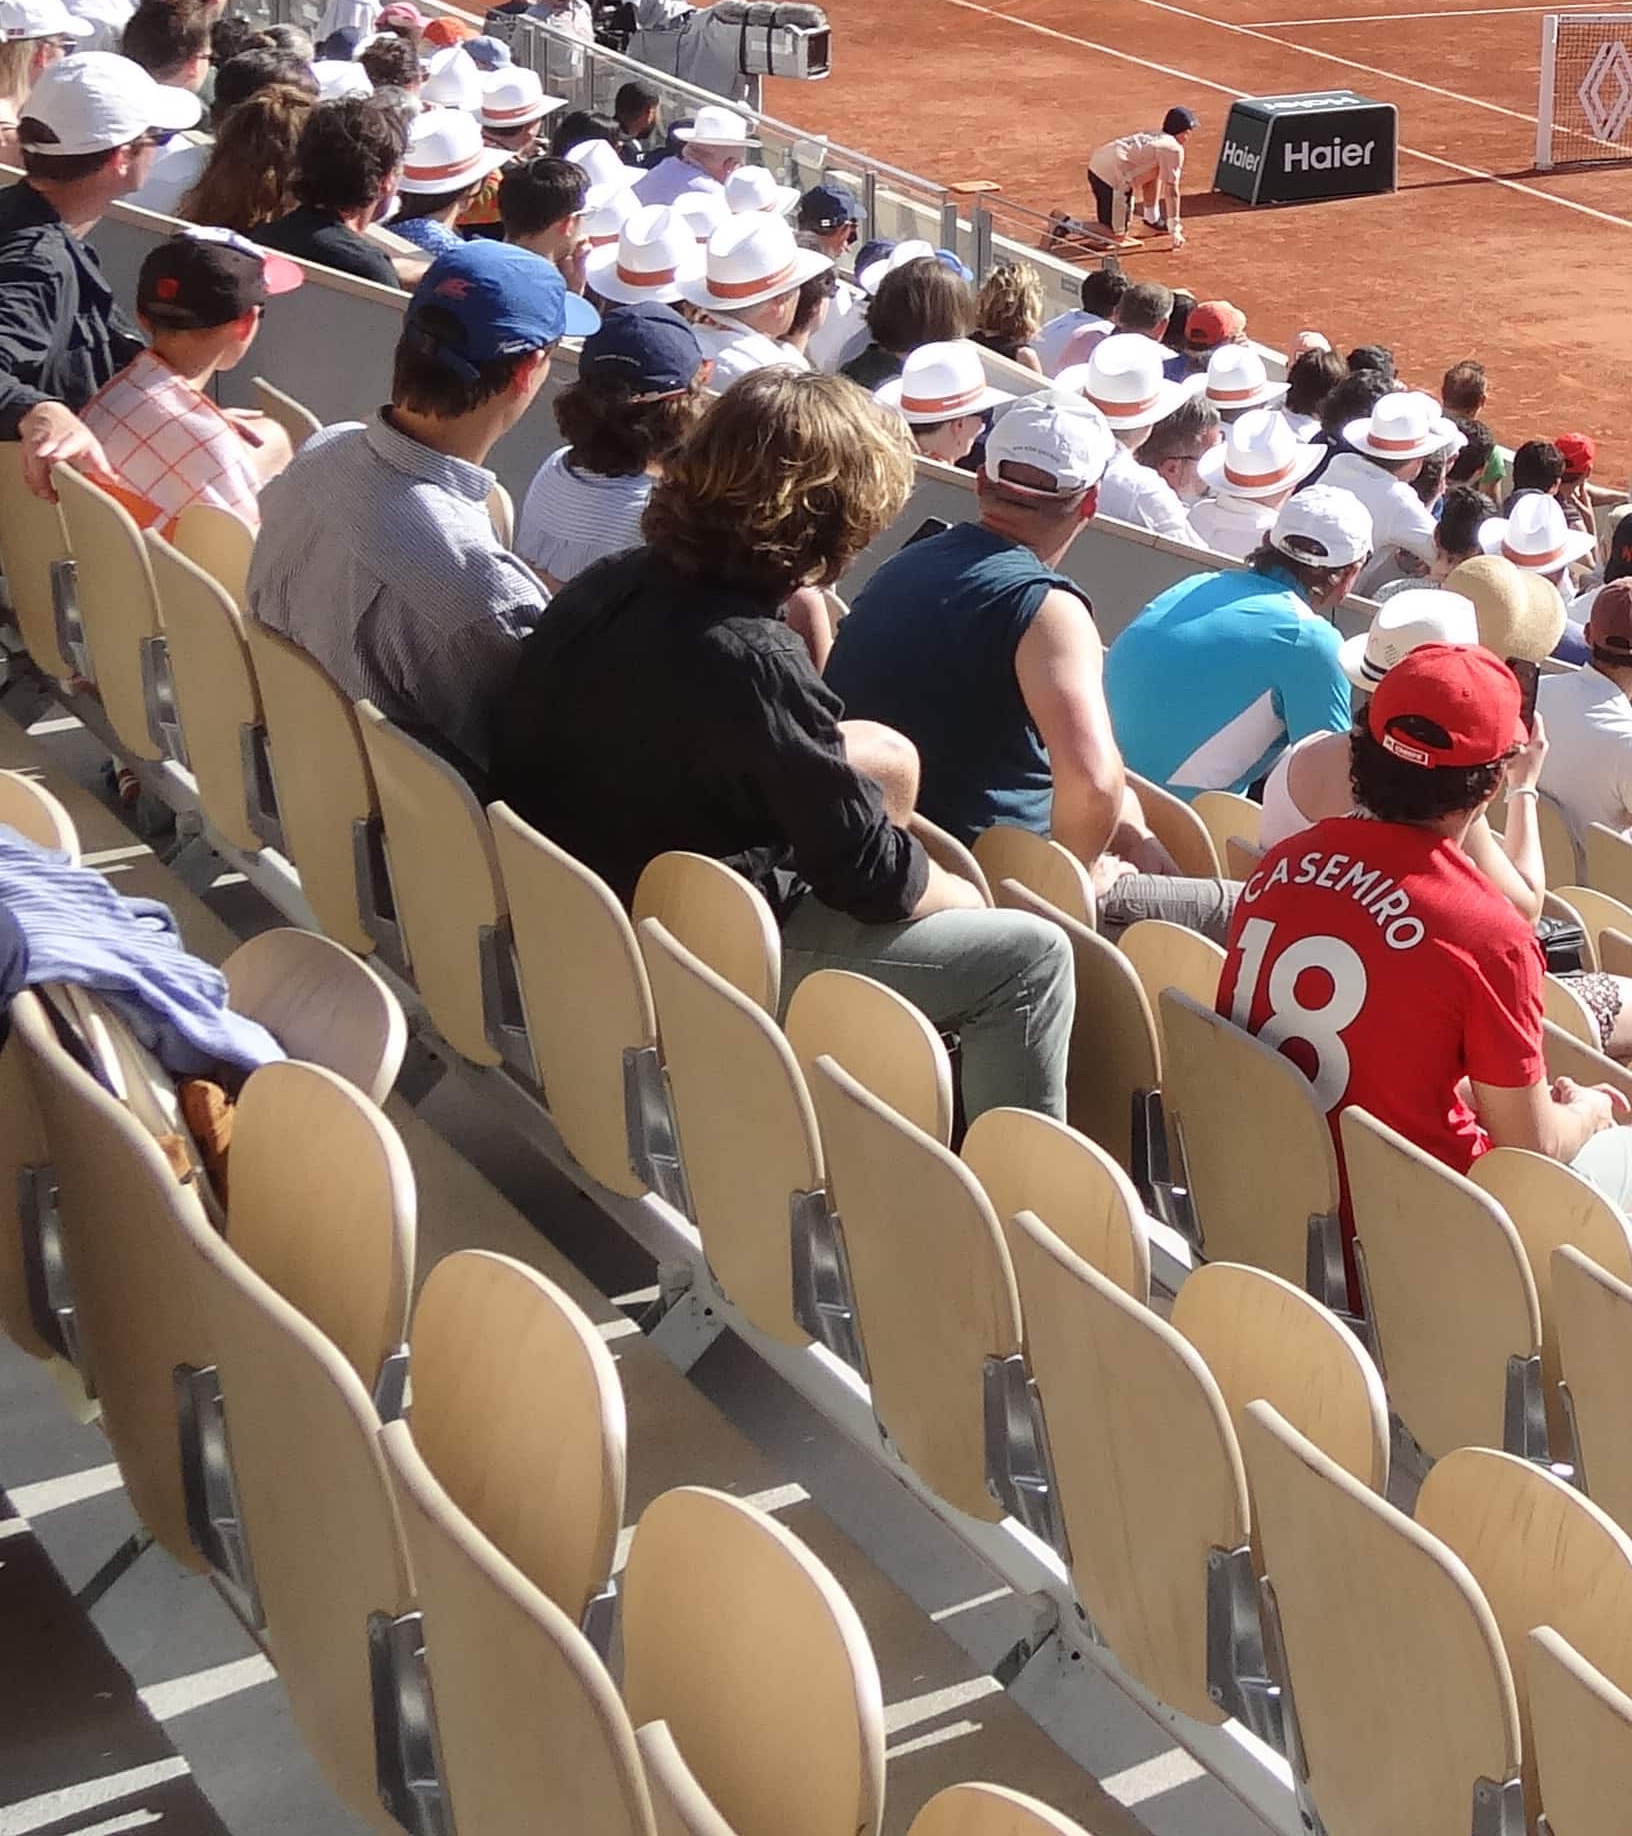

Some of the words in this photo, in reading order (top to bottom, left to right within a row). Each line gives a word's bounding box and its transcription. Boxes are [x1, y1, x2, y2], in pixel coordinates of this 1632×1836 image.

[1222, 140, 1261, 173] Haier
[1283, 136, 1376, 173] Haier
[1243, 851, 1426, 950] CASEMIRO
[1231, 916, 1368, 1116] 18
